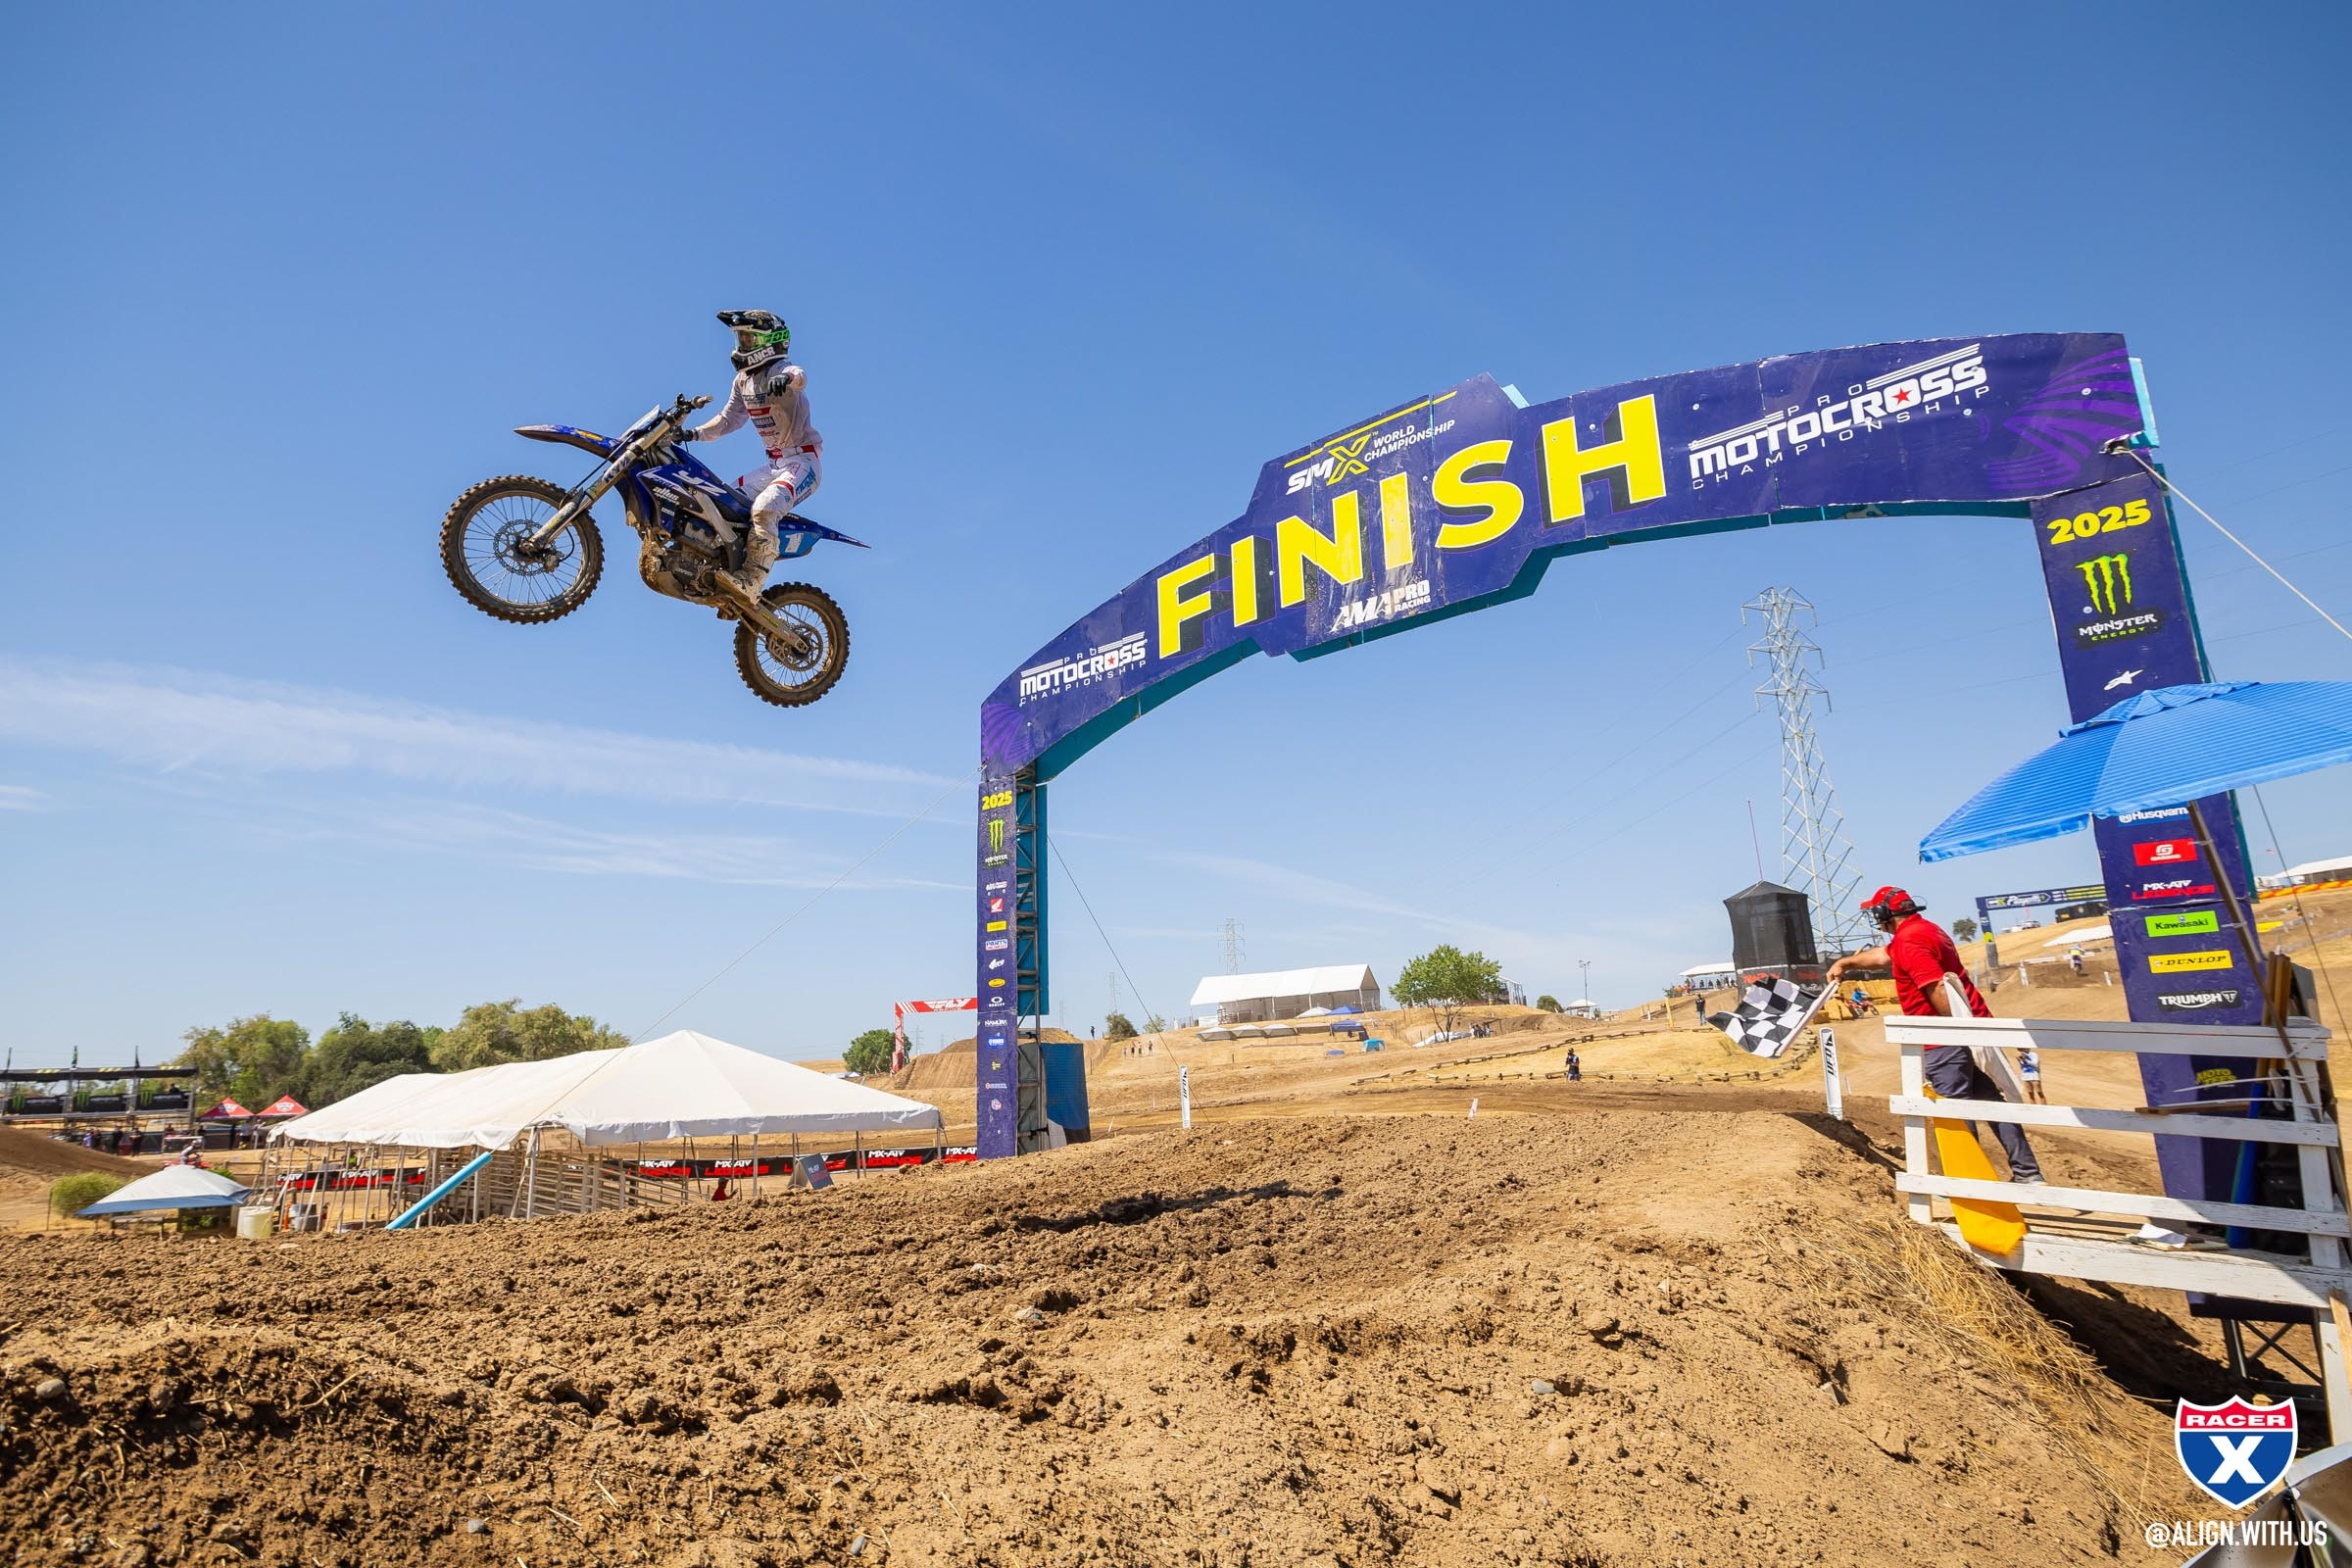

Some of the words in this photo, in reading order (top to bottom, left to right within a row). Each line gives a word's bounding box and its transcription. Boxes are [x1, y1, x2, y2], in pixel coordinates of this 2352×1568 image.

[748, 346, 775, 366] ANCR
[1787, 383, 1863, 417] PRO
[1689, 355, 1988, 478] MOTOCROSS
[1363, 418, 1455, 463] CHAMPIONSHIP
[1373, 424, 1415, 449] WORLD
[1692, 385, 1990, 490] CHAMPIONSHIP
[1286, 433, 1372, 496] SMX
[1156, 393, 1667, 660] FINISH
[2046, 498, 2152, 546] 2025
[1329, 591, 1393, 633] AMA
[1393, 579, 1431, 605] PRO
[1395, 594, 1432, 612] RACING
[2078, 612, 2158, 637] MONSTER
[2090, 625, 2146, 641] ENERGY
[1063, 647, 1098, 664] PRO
[1019, 640, 1147, 698] MOTOCROSS
[1019, 660, 1147, 706] CHAMPIONSHIP
[981, 790, 1013, 811] 2025
[2132, 807, 2190, 820] Husqvarn
[2143, 879, 2192, 892] MX-ATV
[2155, 918, 2210, 930] Kawasaki
[2164, 956, 2227, 966] DUNLOP
[2158, 992, 2224, 1008] TRIUMPH
[1824, 1047, 1835, 1076] UFO
